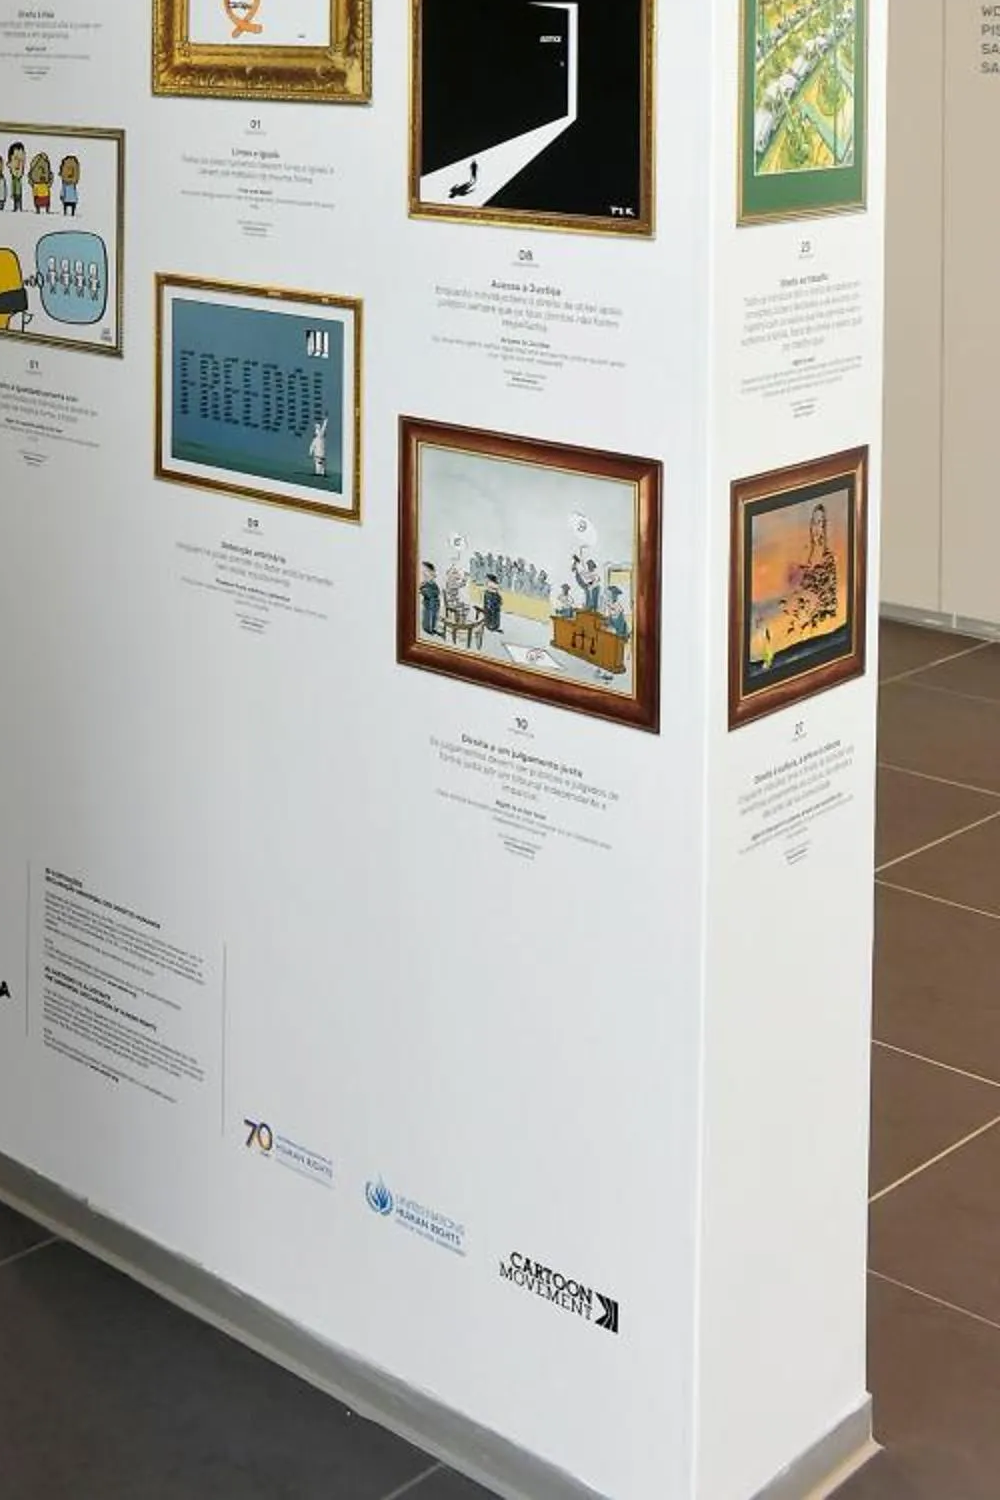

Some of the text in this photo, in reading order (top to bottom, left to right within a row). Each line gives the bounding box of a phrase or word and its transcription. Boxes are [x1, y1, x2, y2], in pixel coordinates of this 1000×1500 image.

[515, 717, 528, 730] 10
[243, 1118, 273, 1150] 70
[396, 1207, 429, 1229] HUMAN
[430, 1222, 461, 1245] RIGHTS
[498, 1260, 593, 1321] MOVEMENT
[509, 1251, 593, 1305] CARTOON
